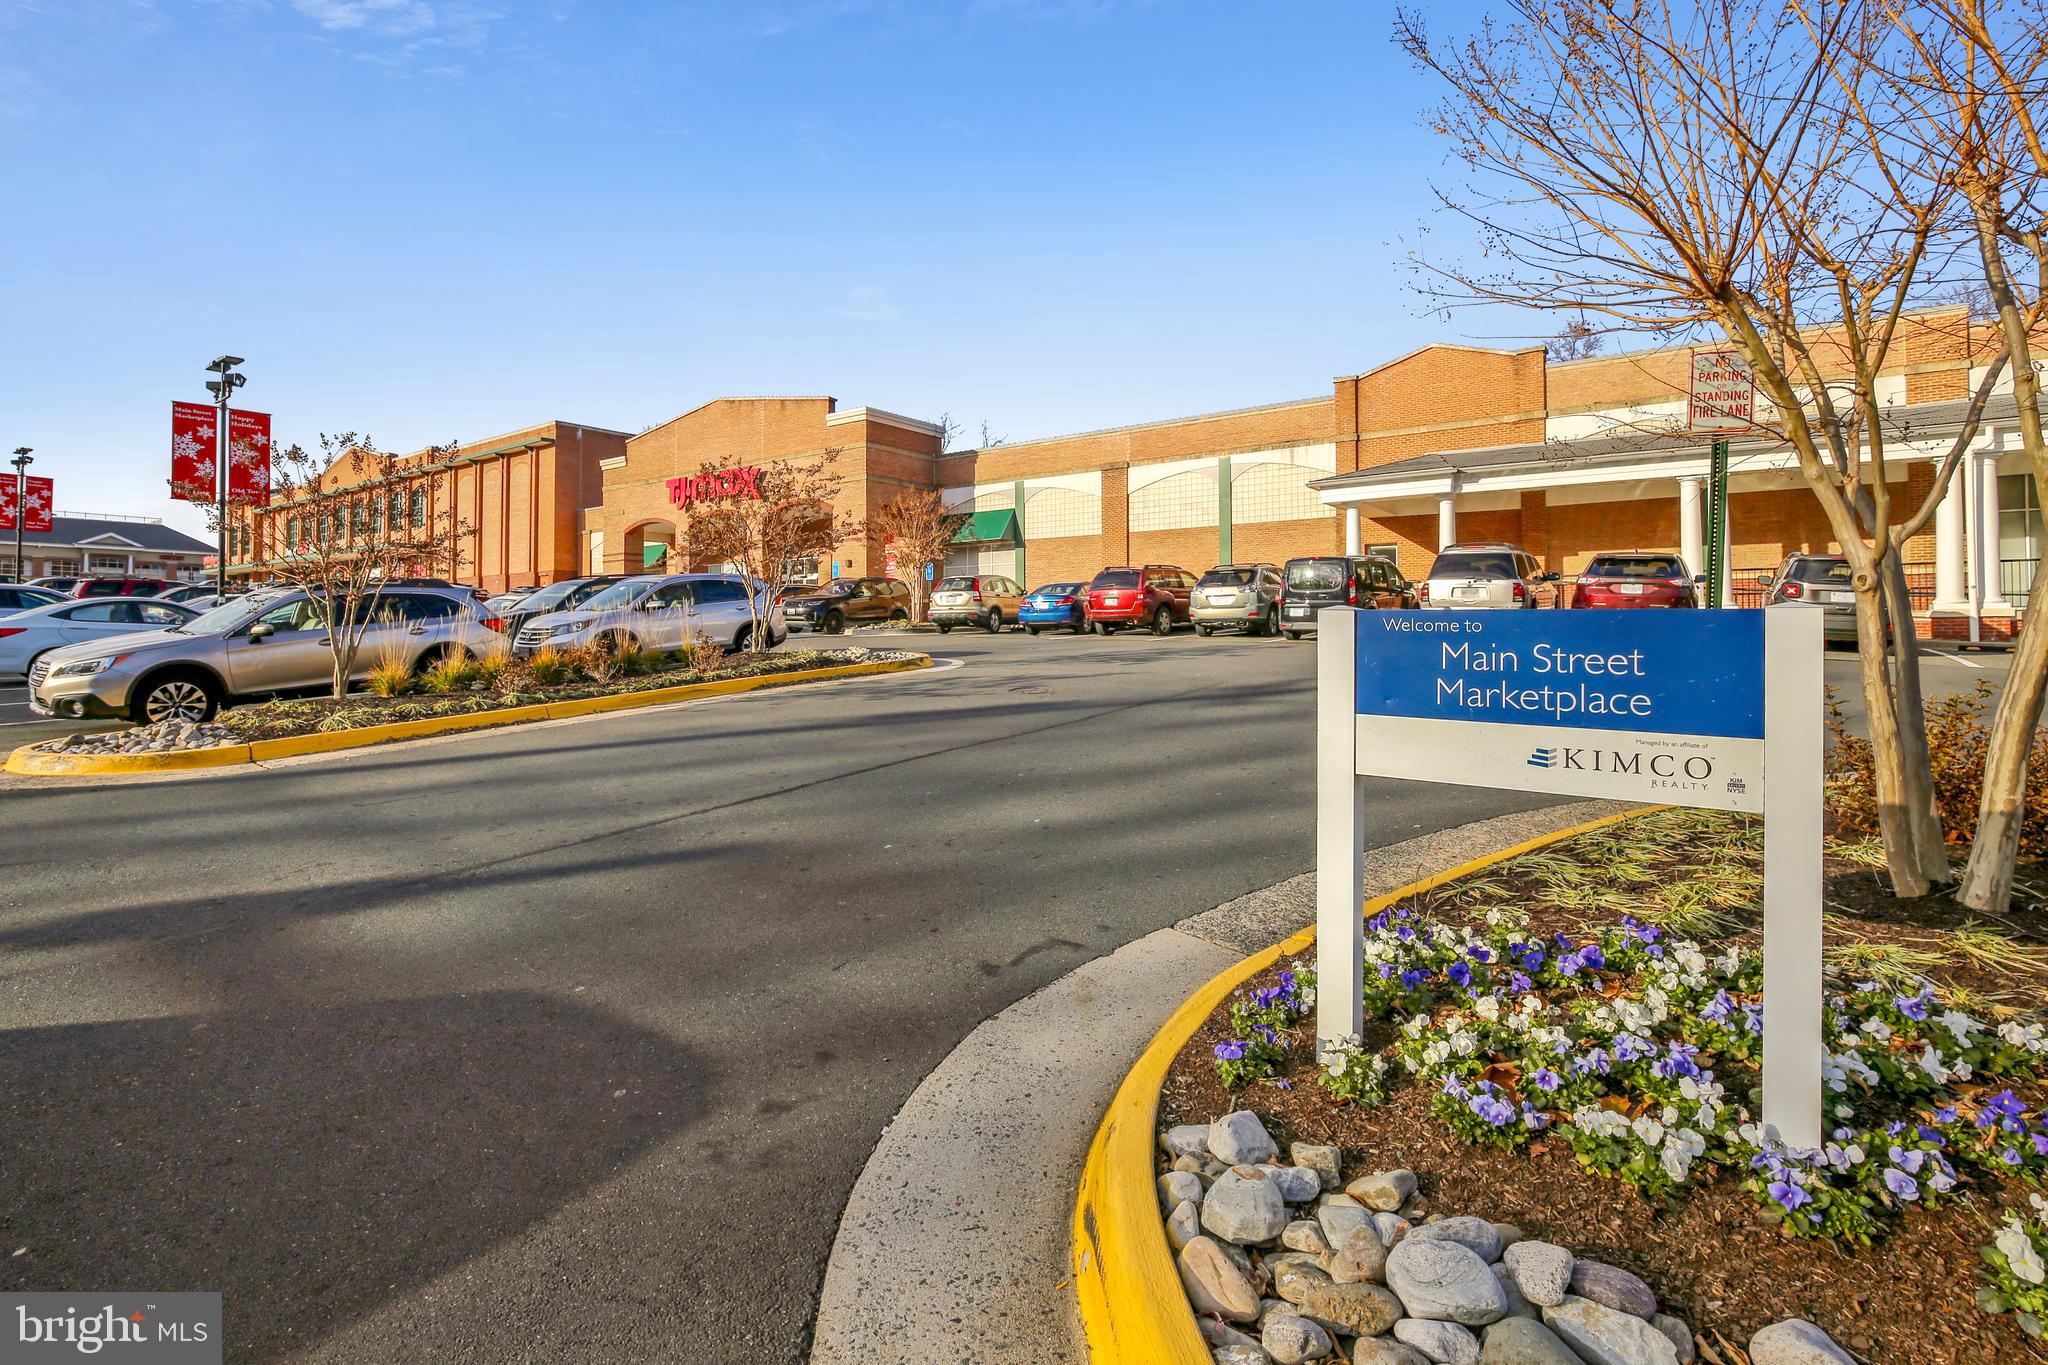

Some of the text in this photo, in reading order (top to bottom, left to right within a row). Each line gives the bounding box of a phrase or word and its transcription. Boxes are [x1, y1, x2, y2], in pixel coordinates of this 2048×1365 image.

[1715, 357, 1731, 368] NO
[1698, 370, 1747, 382] PARKING
[1695, 390, 1749, 402] STANDING
[1693, 404, 1749, 418] FIRE LANE
[174, 413, 214, 422] Marketplace
[231, 415, 255, 423] Happy
[231, 421, 263, 429] Holidays
[1382, 617, 1483, 633] Welcome to
[1440, 641, 1646, 677] Main Street
[1435, 677, 1652, 721] Marketplace
[1635, 739, 1661, 747] Managed
[1562, 747, 1713, 780] KIMCO
[1651, 780, 1709, 791] REALTY
[1726, 787, 1747, 795] NYSE
